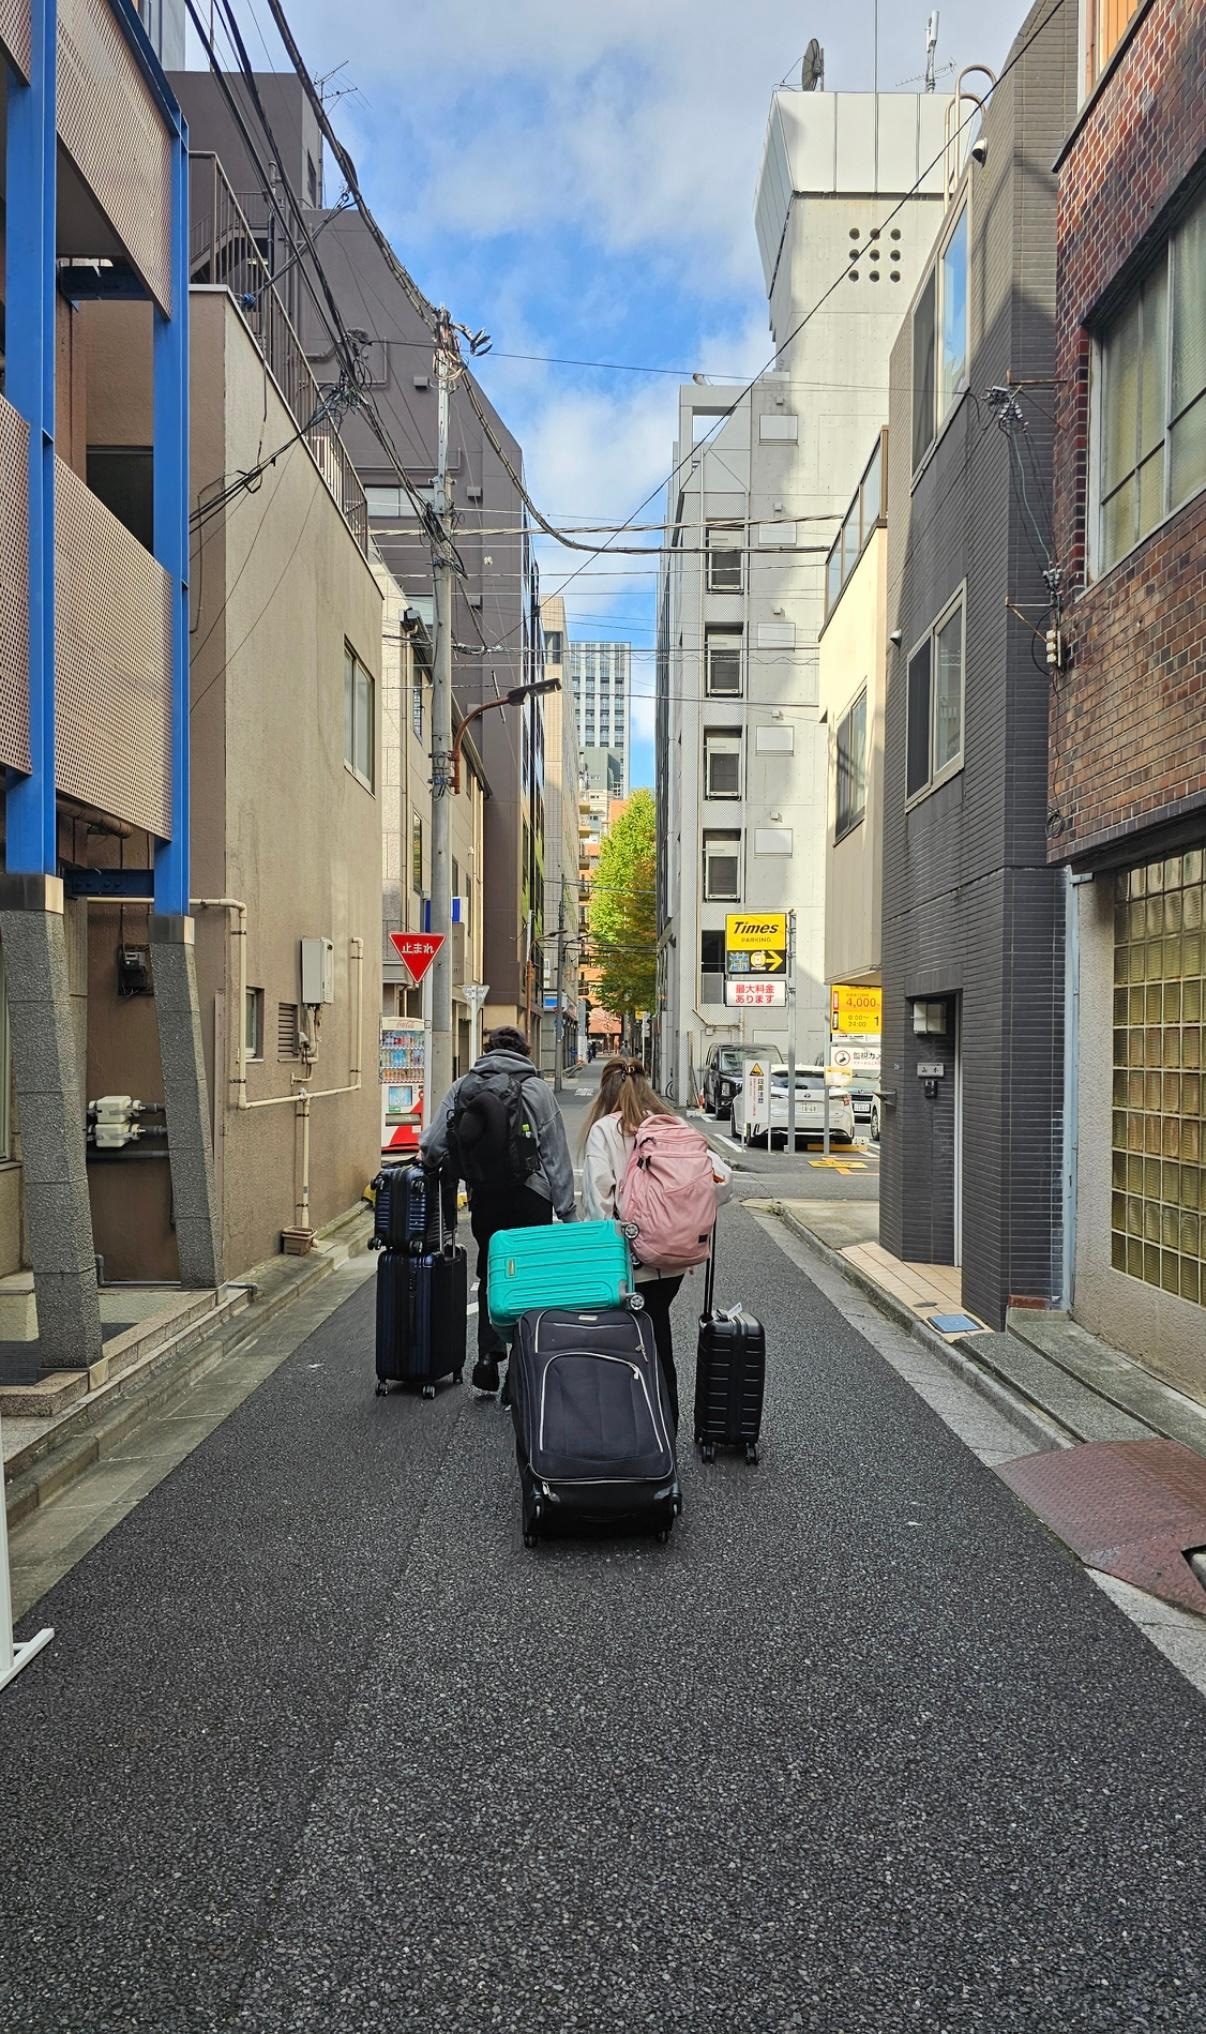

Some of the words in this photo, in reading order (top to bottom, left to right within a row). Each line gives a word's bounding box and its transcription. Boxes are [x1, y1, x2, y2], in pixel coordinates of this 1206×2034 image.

[734, 921, 779, 934] Times
[401, 942, 434, 954] 止まれ
[736, 984, 775, 994] 最大料金
[735, 994, 774, 1004] あります
